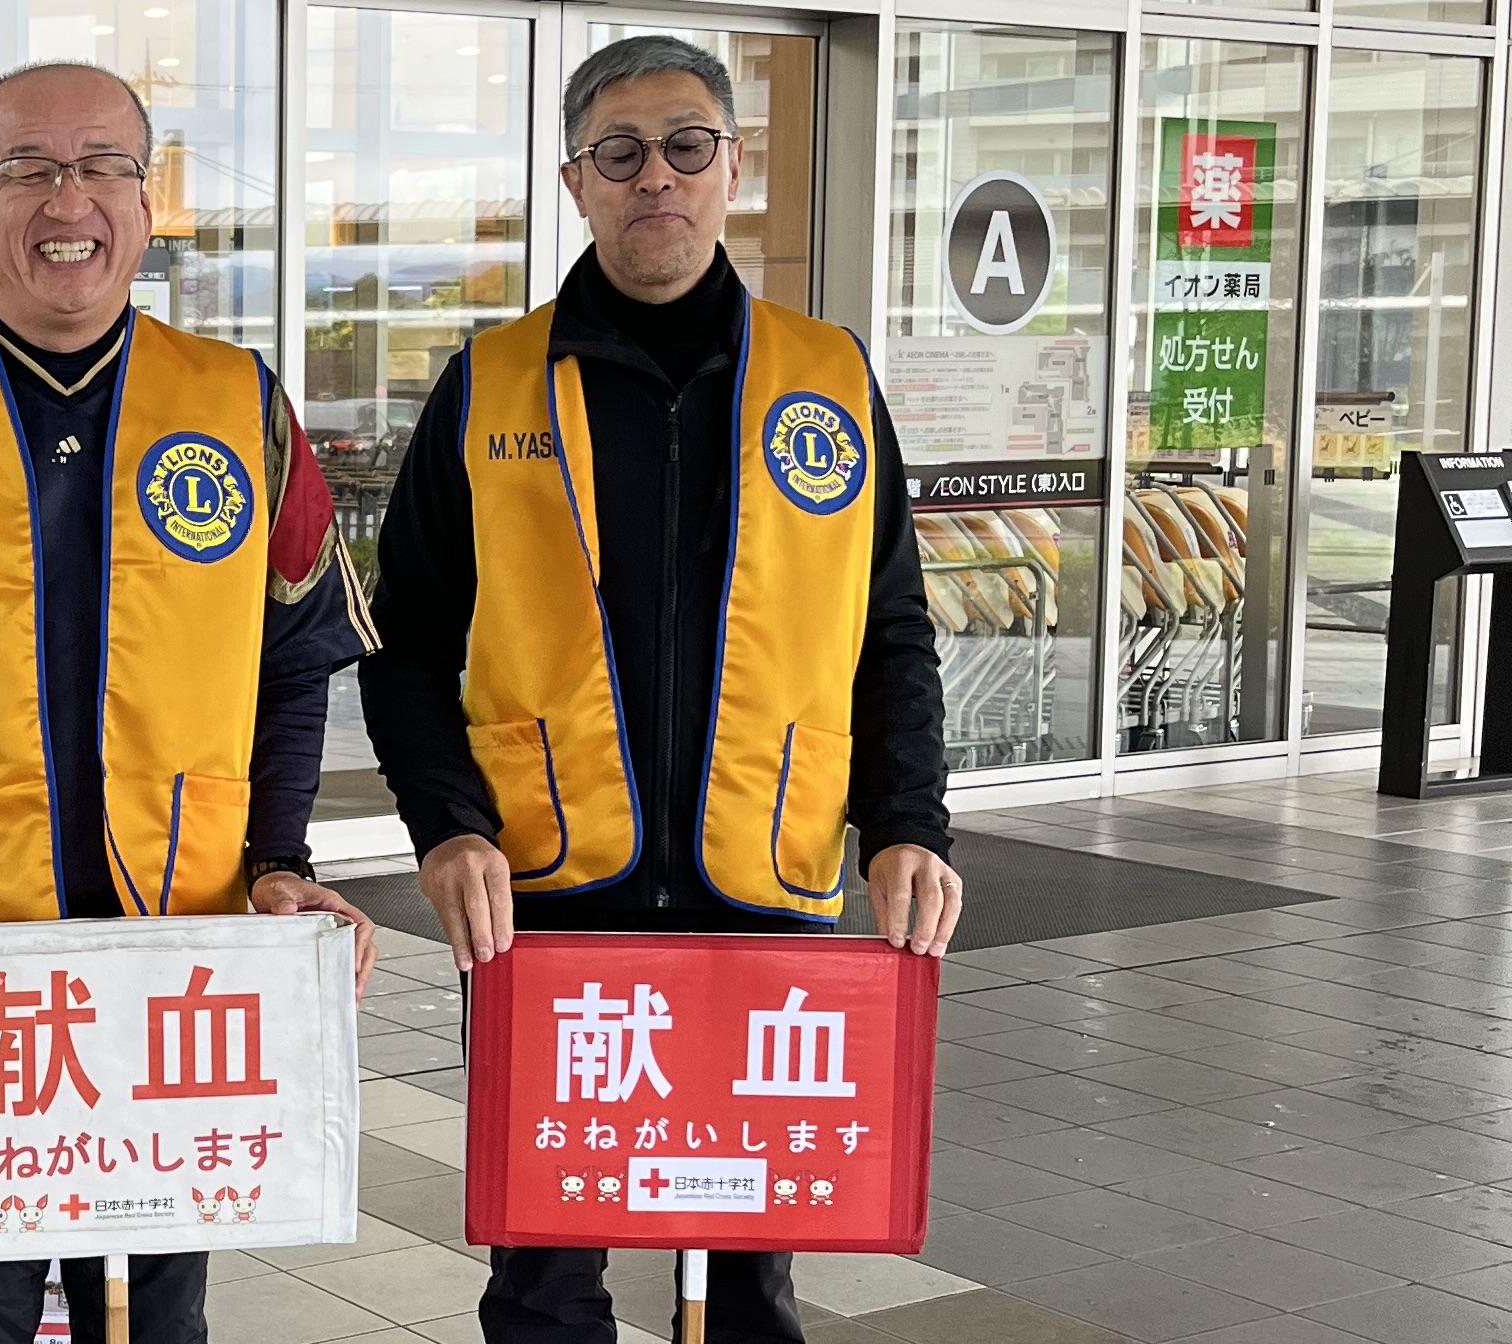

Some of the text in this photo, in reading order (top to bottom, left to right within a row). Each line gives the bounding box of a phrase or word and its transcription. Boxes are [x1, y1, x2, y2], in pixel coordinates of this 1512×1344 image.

[1189, 152, 1243, 230] 薬
[970, 209, 1026, 295] A
[1165, 273, 1261, 299] イオン薬局
[1159, 335, 1259, 373] 処方せん
[785, 405, 837, 429] LIONS
[1183, 387, 1234, 424] 受付
[1339, 409, 1385, 428] ベビー
[165, 446, 226, 472] LIONS
[802, 432, 827, 469] L
[1438, 456, 1505, 470] INFORMATION
[184, 475, 212, 514] L
[978, 474, 1027, 496] STYLE
[169, 519, 227, 542] INTERNATIONAL
[535, 1116, 870, 1155] おねがいします
[674, 1176, 755, 1192] 日本赤十字社
[95, 1197, 175, 1212] 日本赤十字社
